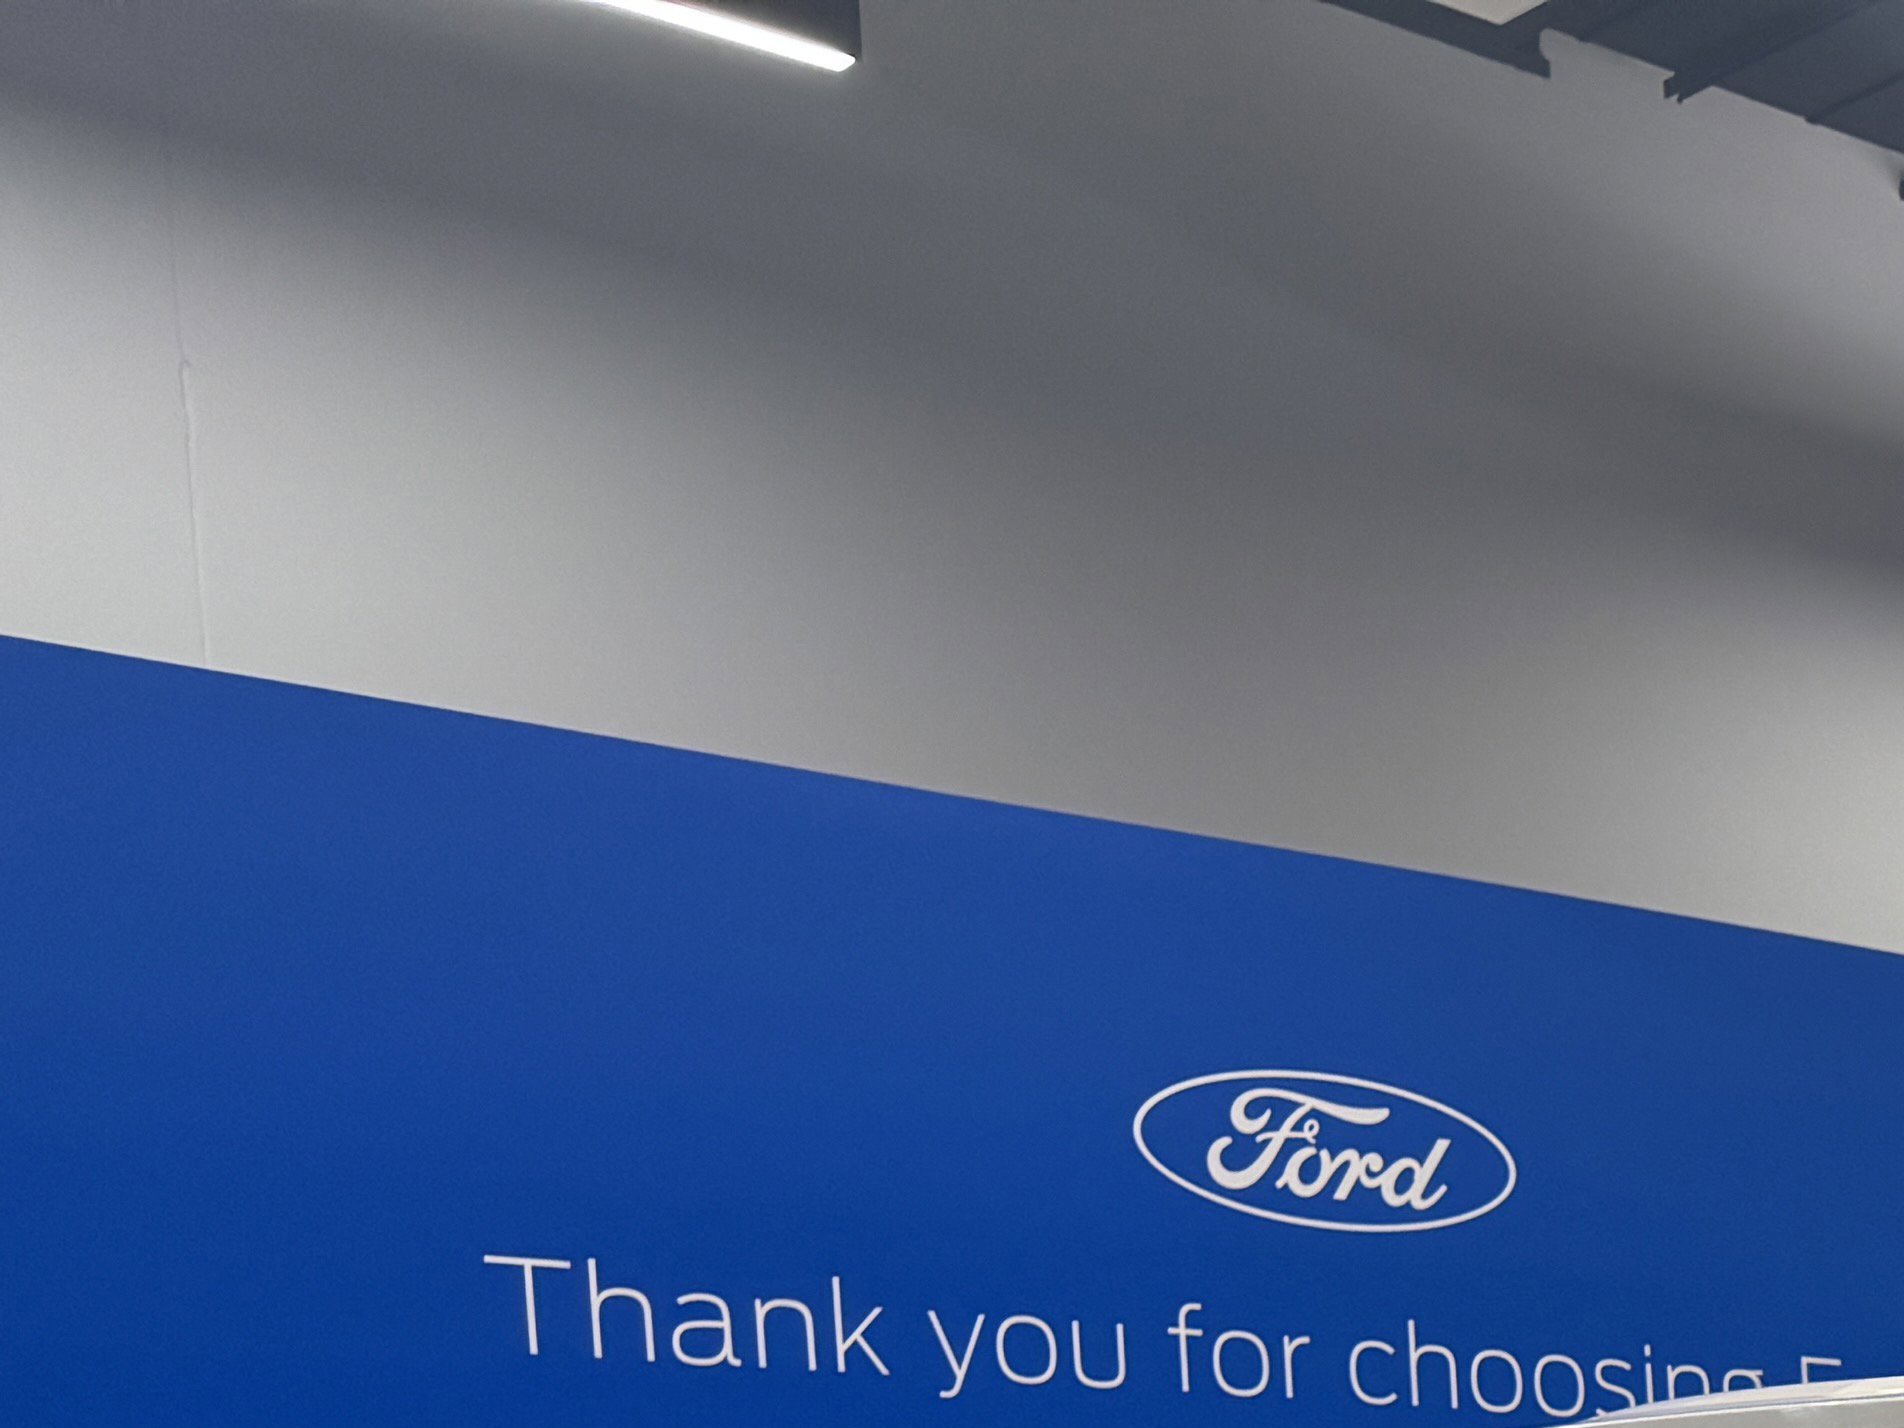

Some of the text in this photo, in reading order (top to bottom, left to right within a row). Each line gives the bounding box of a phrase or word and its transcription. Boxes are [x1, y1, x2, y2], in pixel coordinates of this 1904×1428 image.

[1206, 1087, 1451, 1210] Ford
[483, 1254, 1763, 1416] Thank you for choosin
